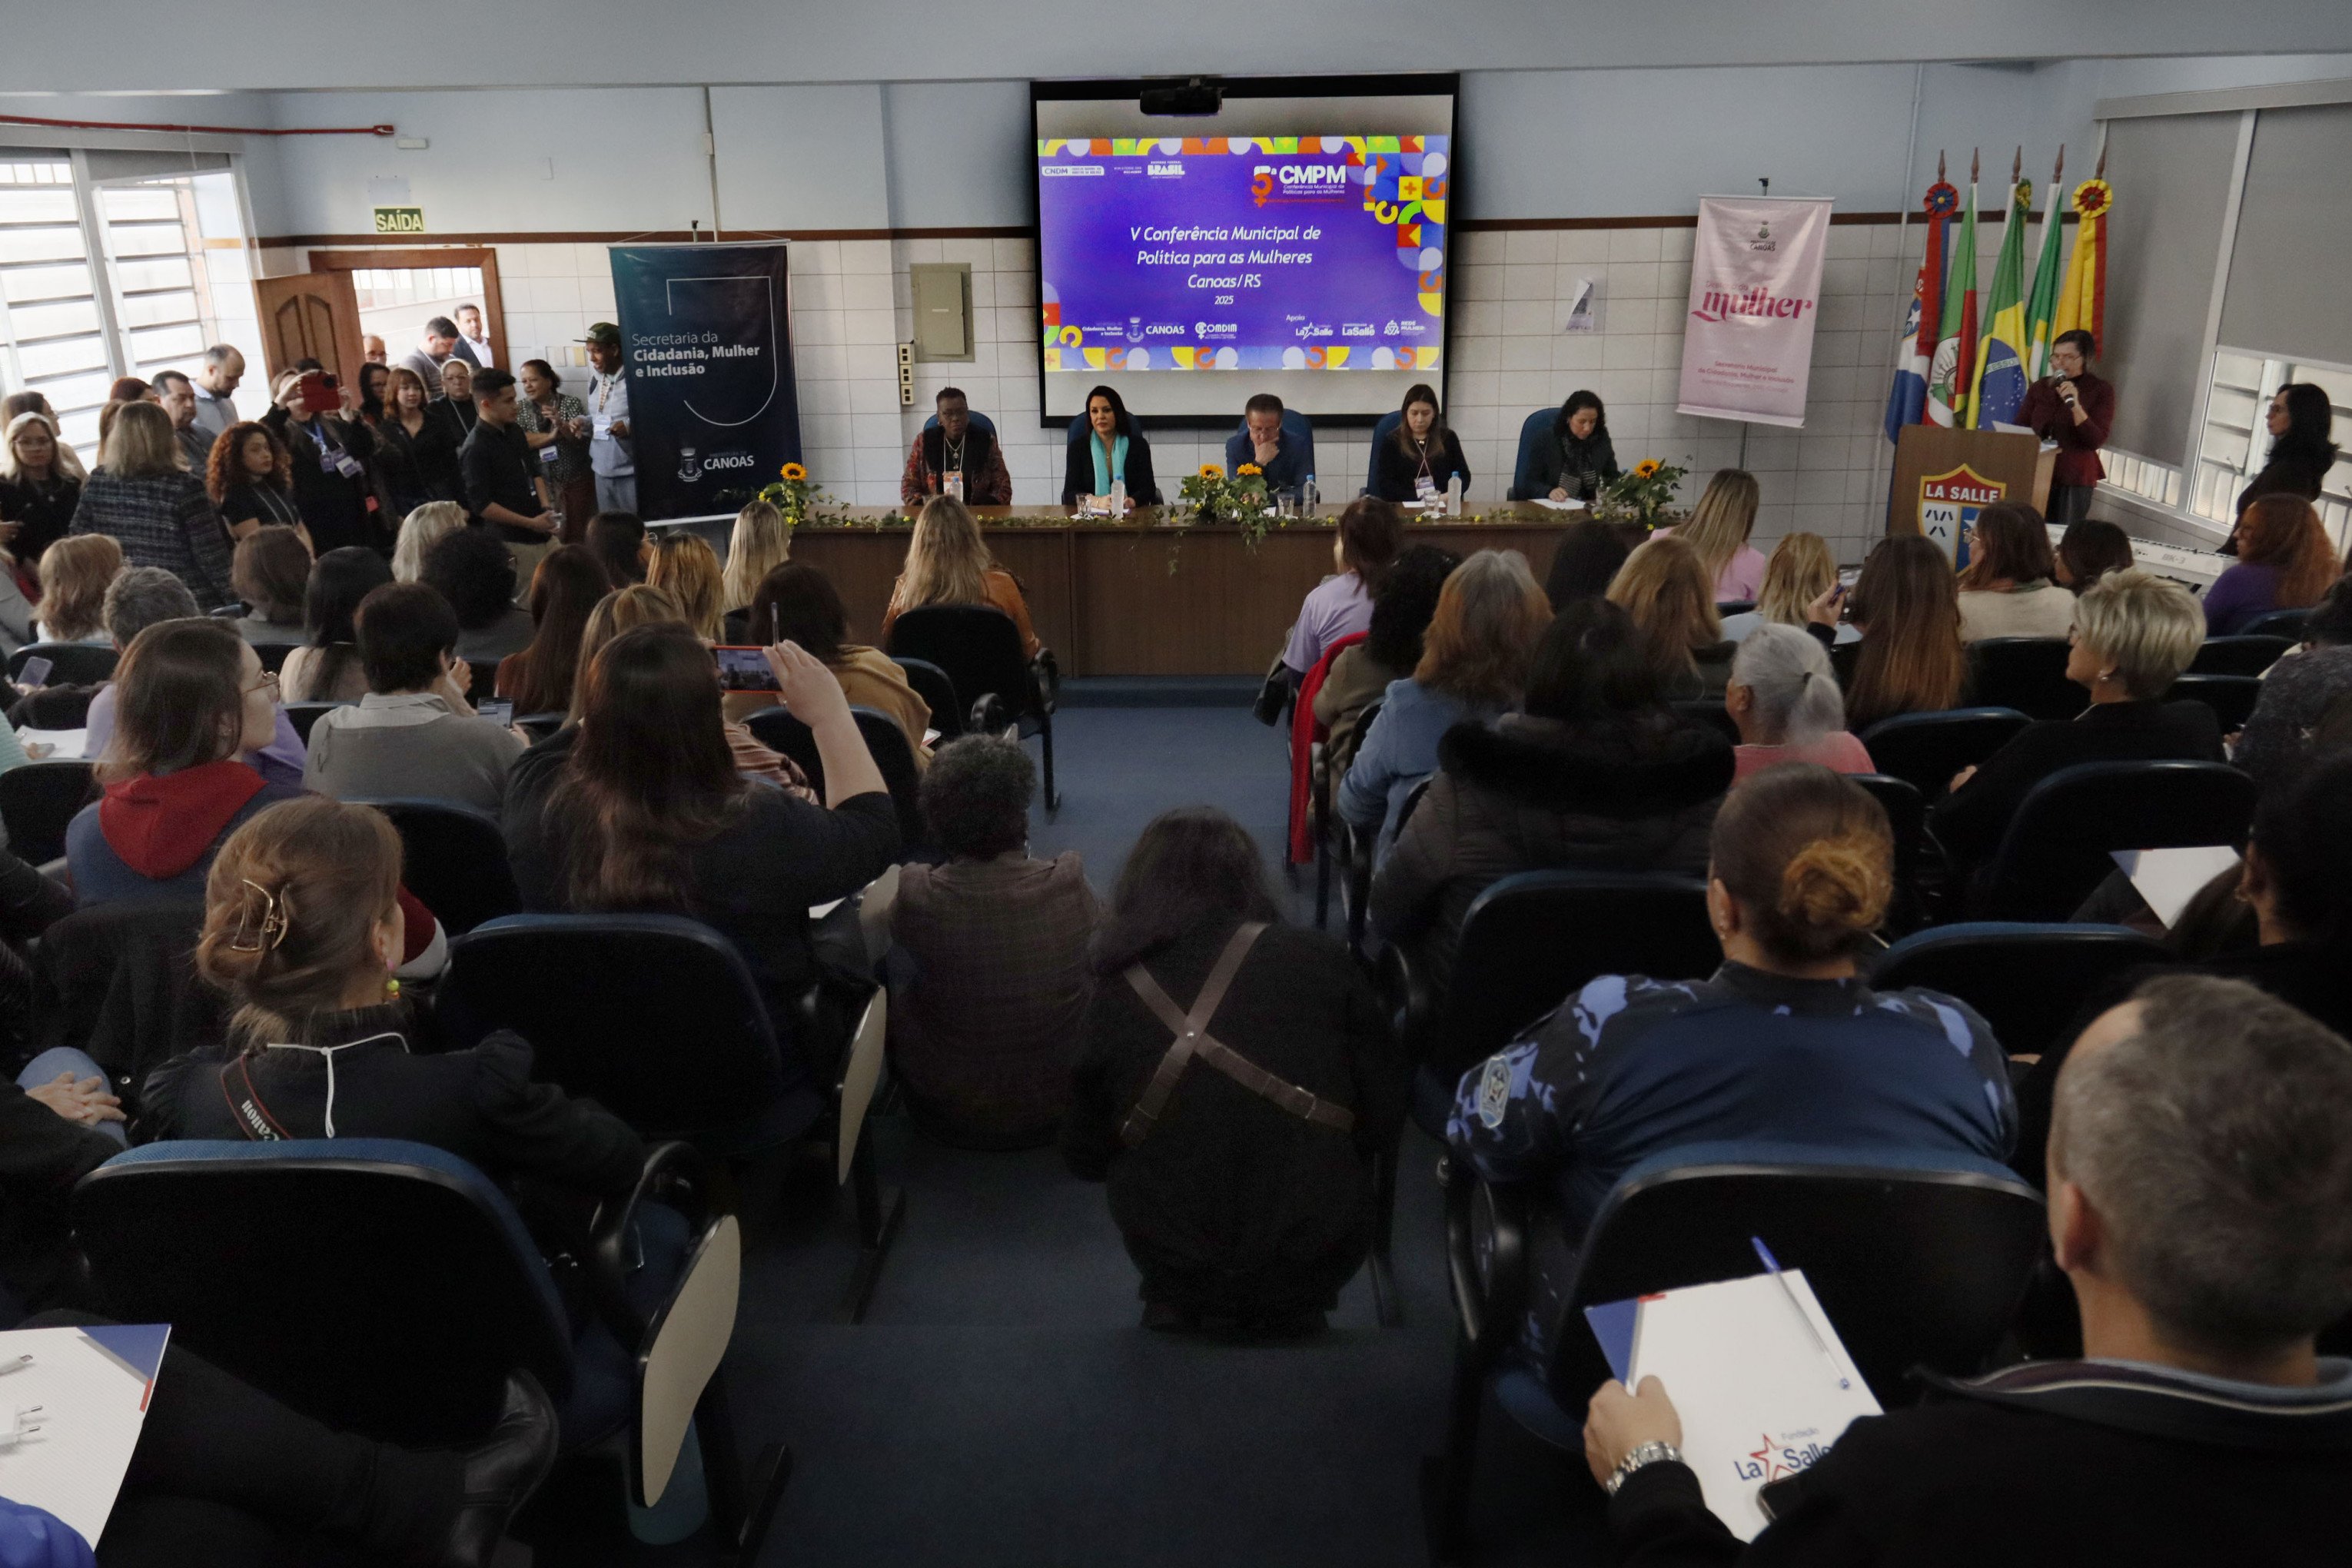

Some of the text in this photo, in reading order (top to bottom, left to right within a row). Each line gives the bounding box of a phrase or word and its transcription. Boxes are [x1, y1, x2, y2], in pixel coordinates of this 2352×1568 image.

[1148, 164, 1185, 175] BRASIL
[1279, 165, 1346, 184] CMPM
[376, 209, 423, 231] SAÍDA
[1131, 225, 1321, 244] V Conferência Municipal de
[1138, 250, 1313, 267] Política para as Mulheres
[1188, 274, 1262, 289] Canoas/RS
[1214, 296, 1234, 305] 2025
[1691, 286, 1813, 322] mulher
[1145, 325, 1185, 335] CANOAS
[1314, 327, 1334, 336] Salle
[632, 331, 718, 347] Secretaria da
[633, 344, 760, 363] Cidadania, Mulher
[636, 363, 706, 377] e Inclusão
[703, 455, 755, 470] CANOAS
[1925, 484, 1998, 503] LA SALLE
[1734, 1460, 1763, 1481] La
